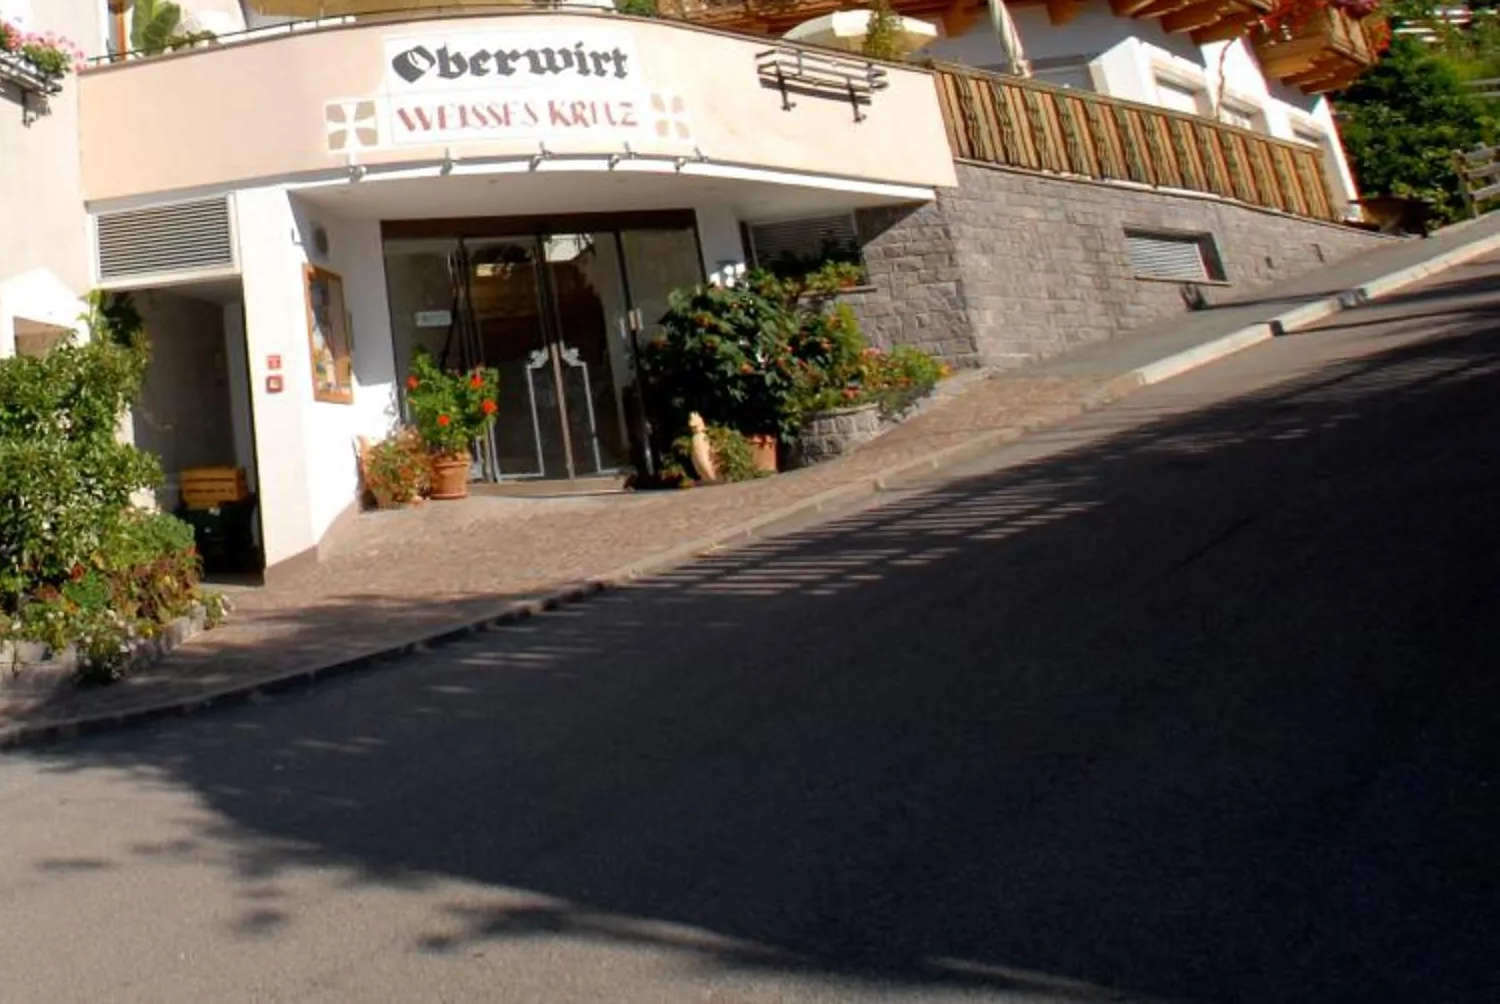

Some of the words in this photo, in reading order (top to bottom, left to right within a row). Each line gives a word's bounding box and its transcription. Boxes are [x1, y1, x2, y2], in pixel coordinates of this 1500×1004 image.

[392, 40, 629, 84] Oberwirt
[396, 100, 539, 132] WEISSES
[547, 99, 639, 128] KREUZ
